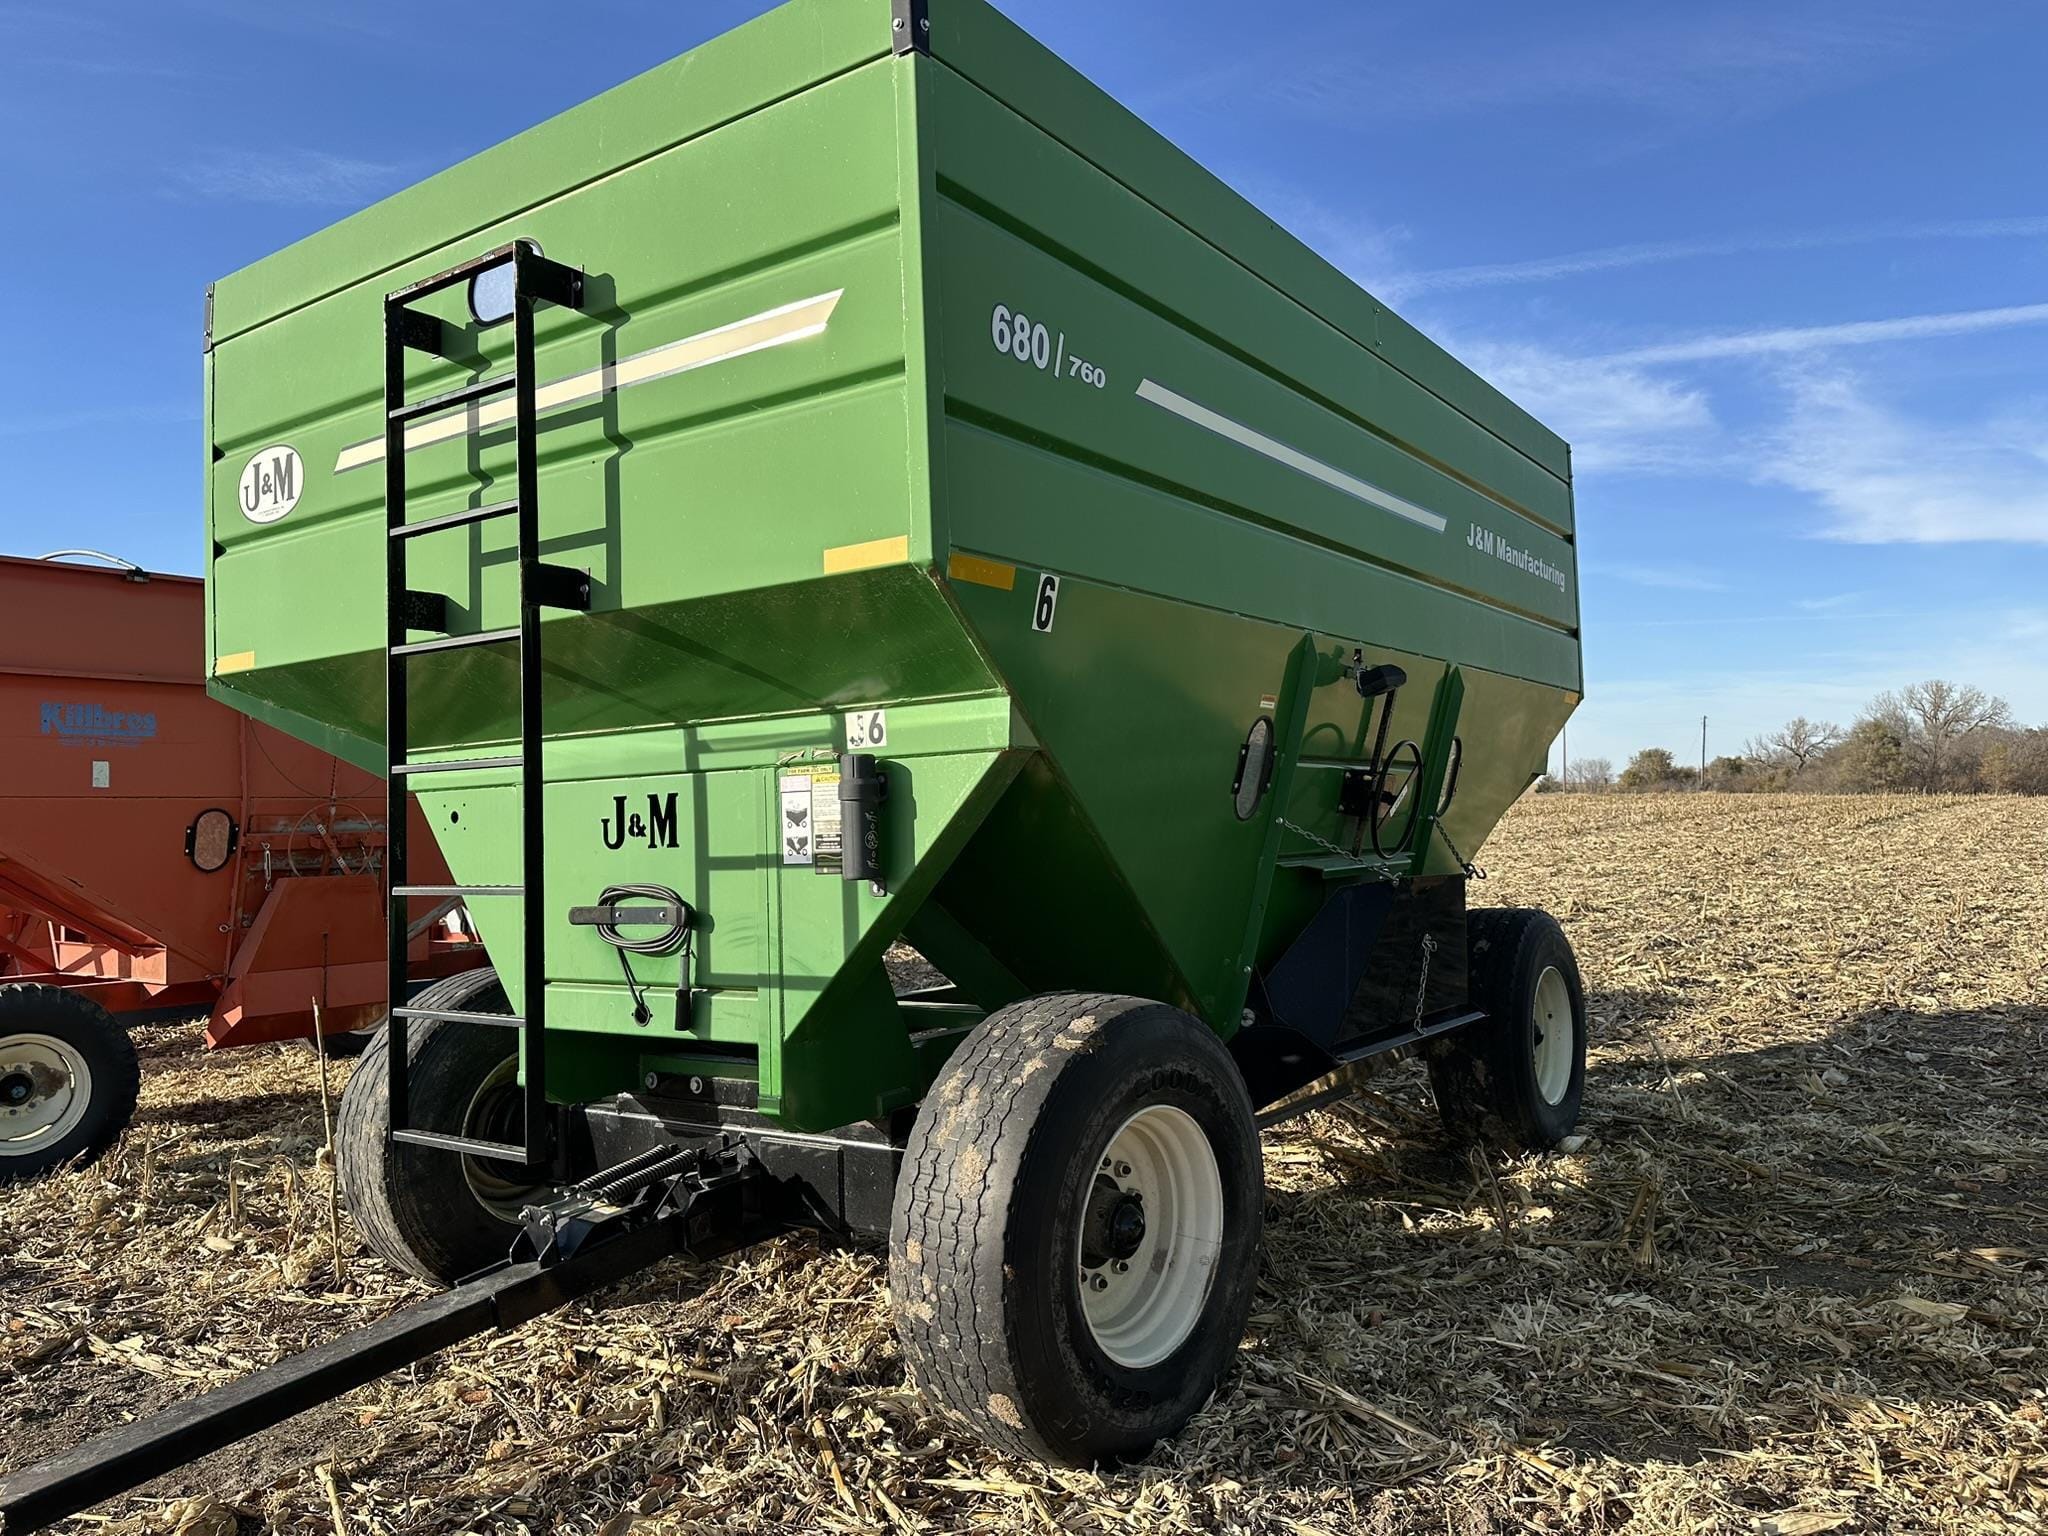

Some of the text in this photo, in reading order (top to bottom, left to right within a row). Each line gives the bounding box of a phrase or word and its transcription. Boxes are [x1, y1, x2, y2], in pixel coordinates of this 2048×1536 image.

[244, 452, 295, 511] J&M
[1467, 523, 1565, 592] J&M Manufacturing
[1036, 576, 1056, 630] 6
[41, 703, 156, 735] Killbros
[601, 792, 680, 849] J&M
